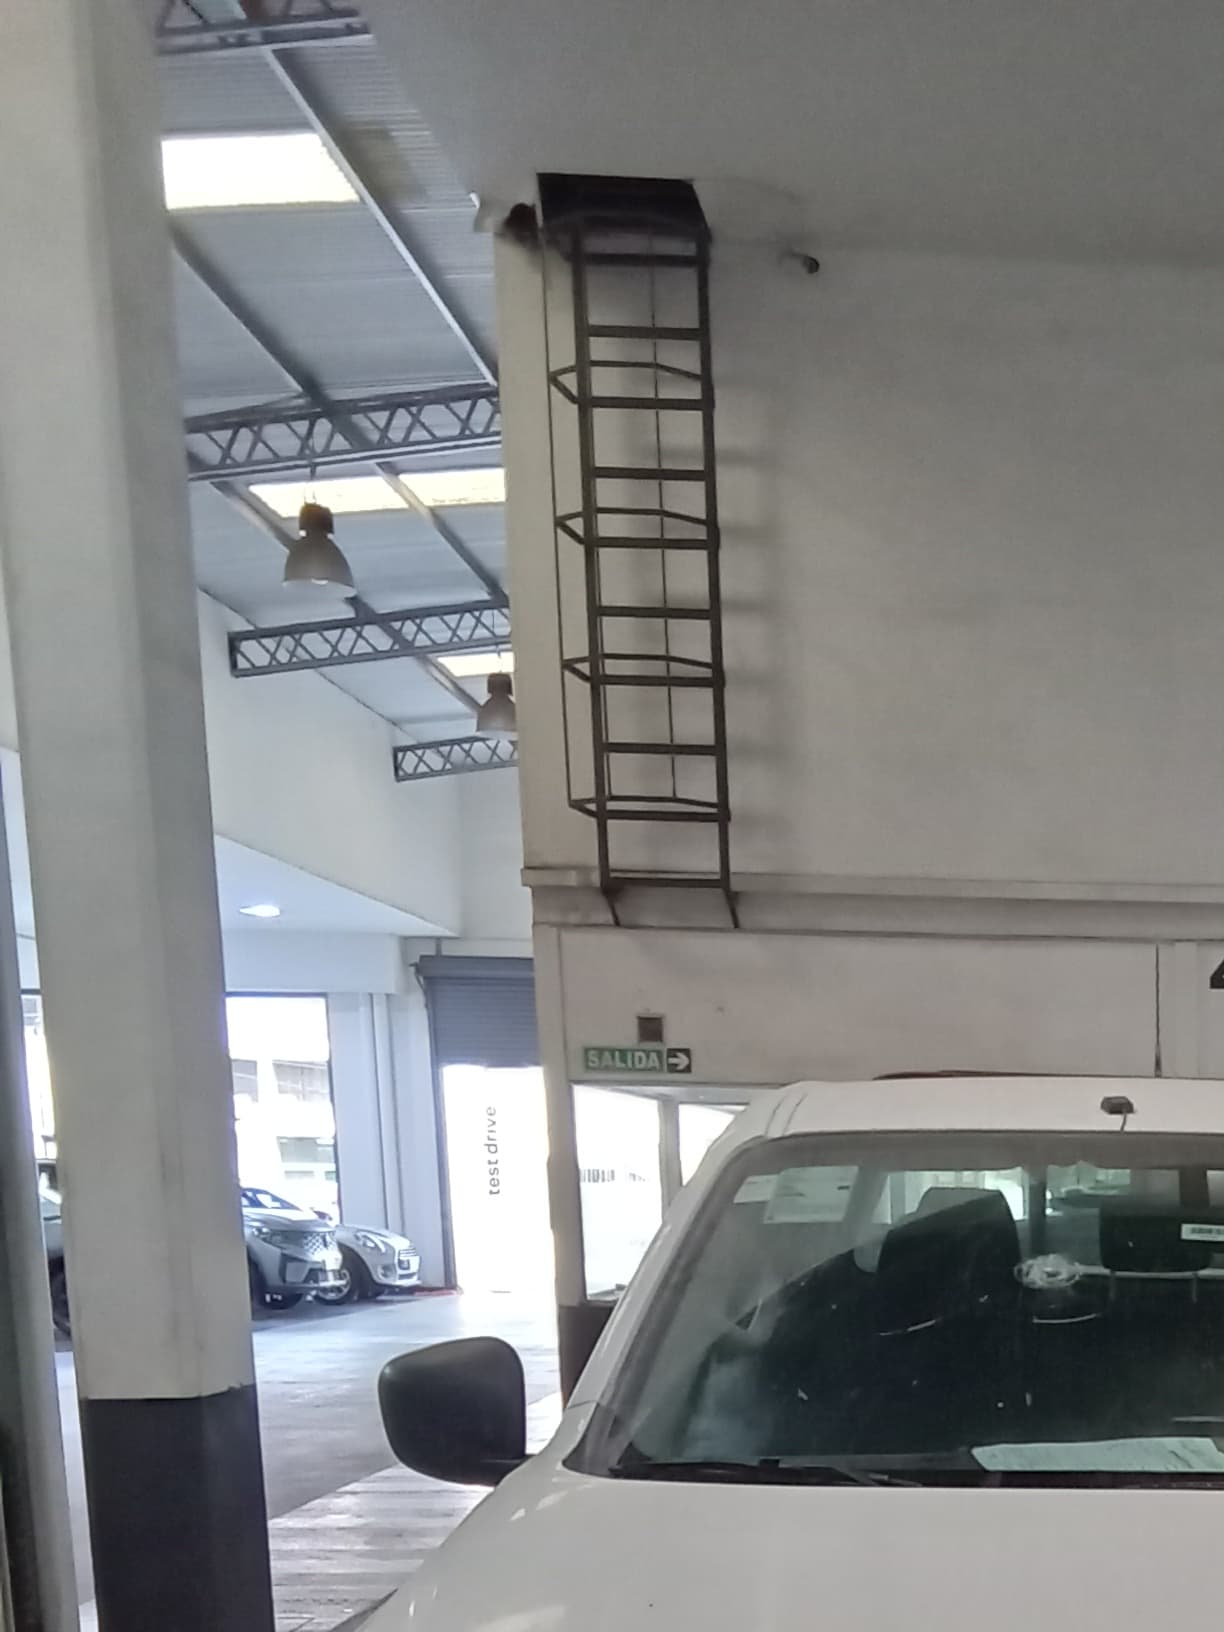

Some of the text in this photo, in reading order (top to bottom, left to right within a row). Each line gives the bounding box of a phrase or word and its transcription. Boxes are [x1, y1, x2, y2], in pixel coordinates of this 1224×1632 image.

[587, 1051, 660, 1069] SALIDA
[484, 1106, 501, 1196] test drive
